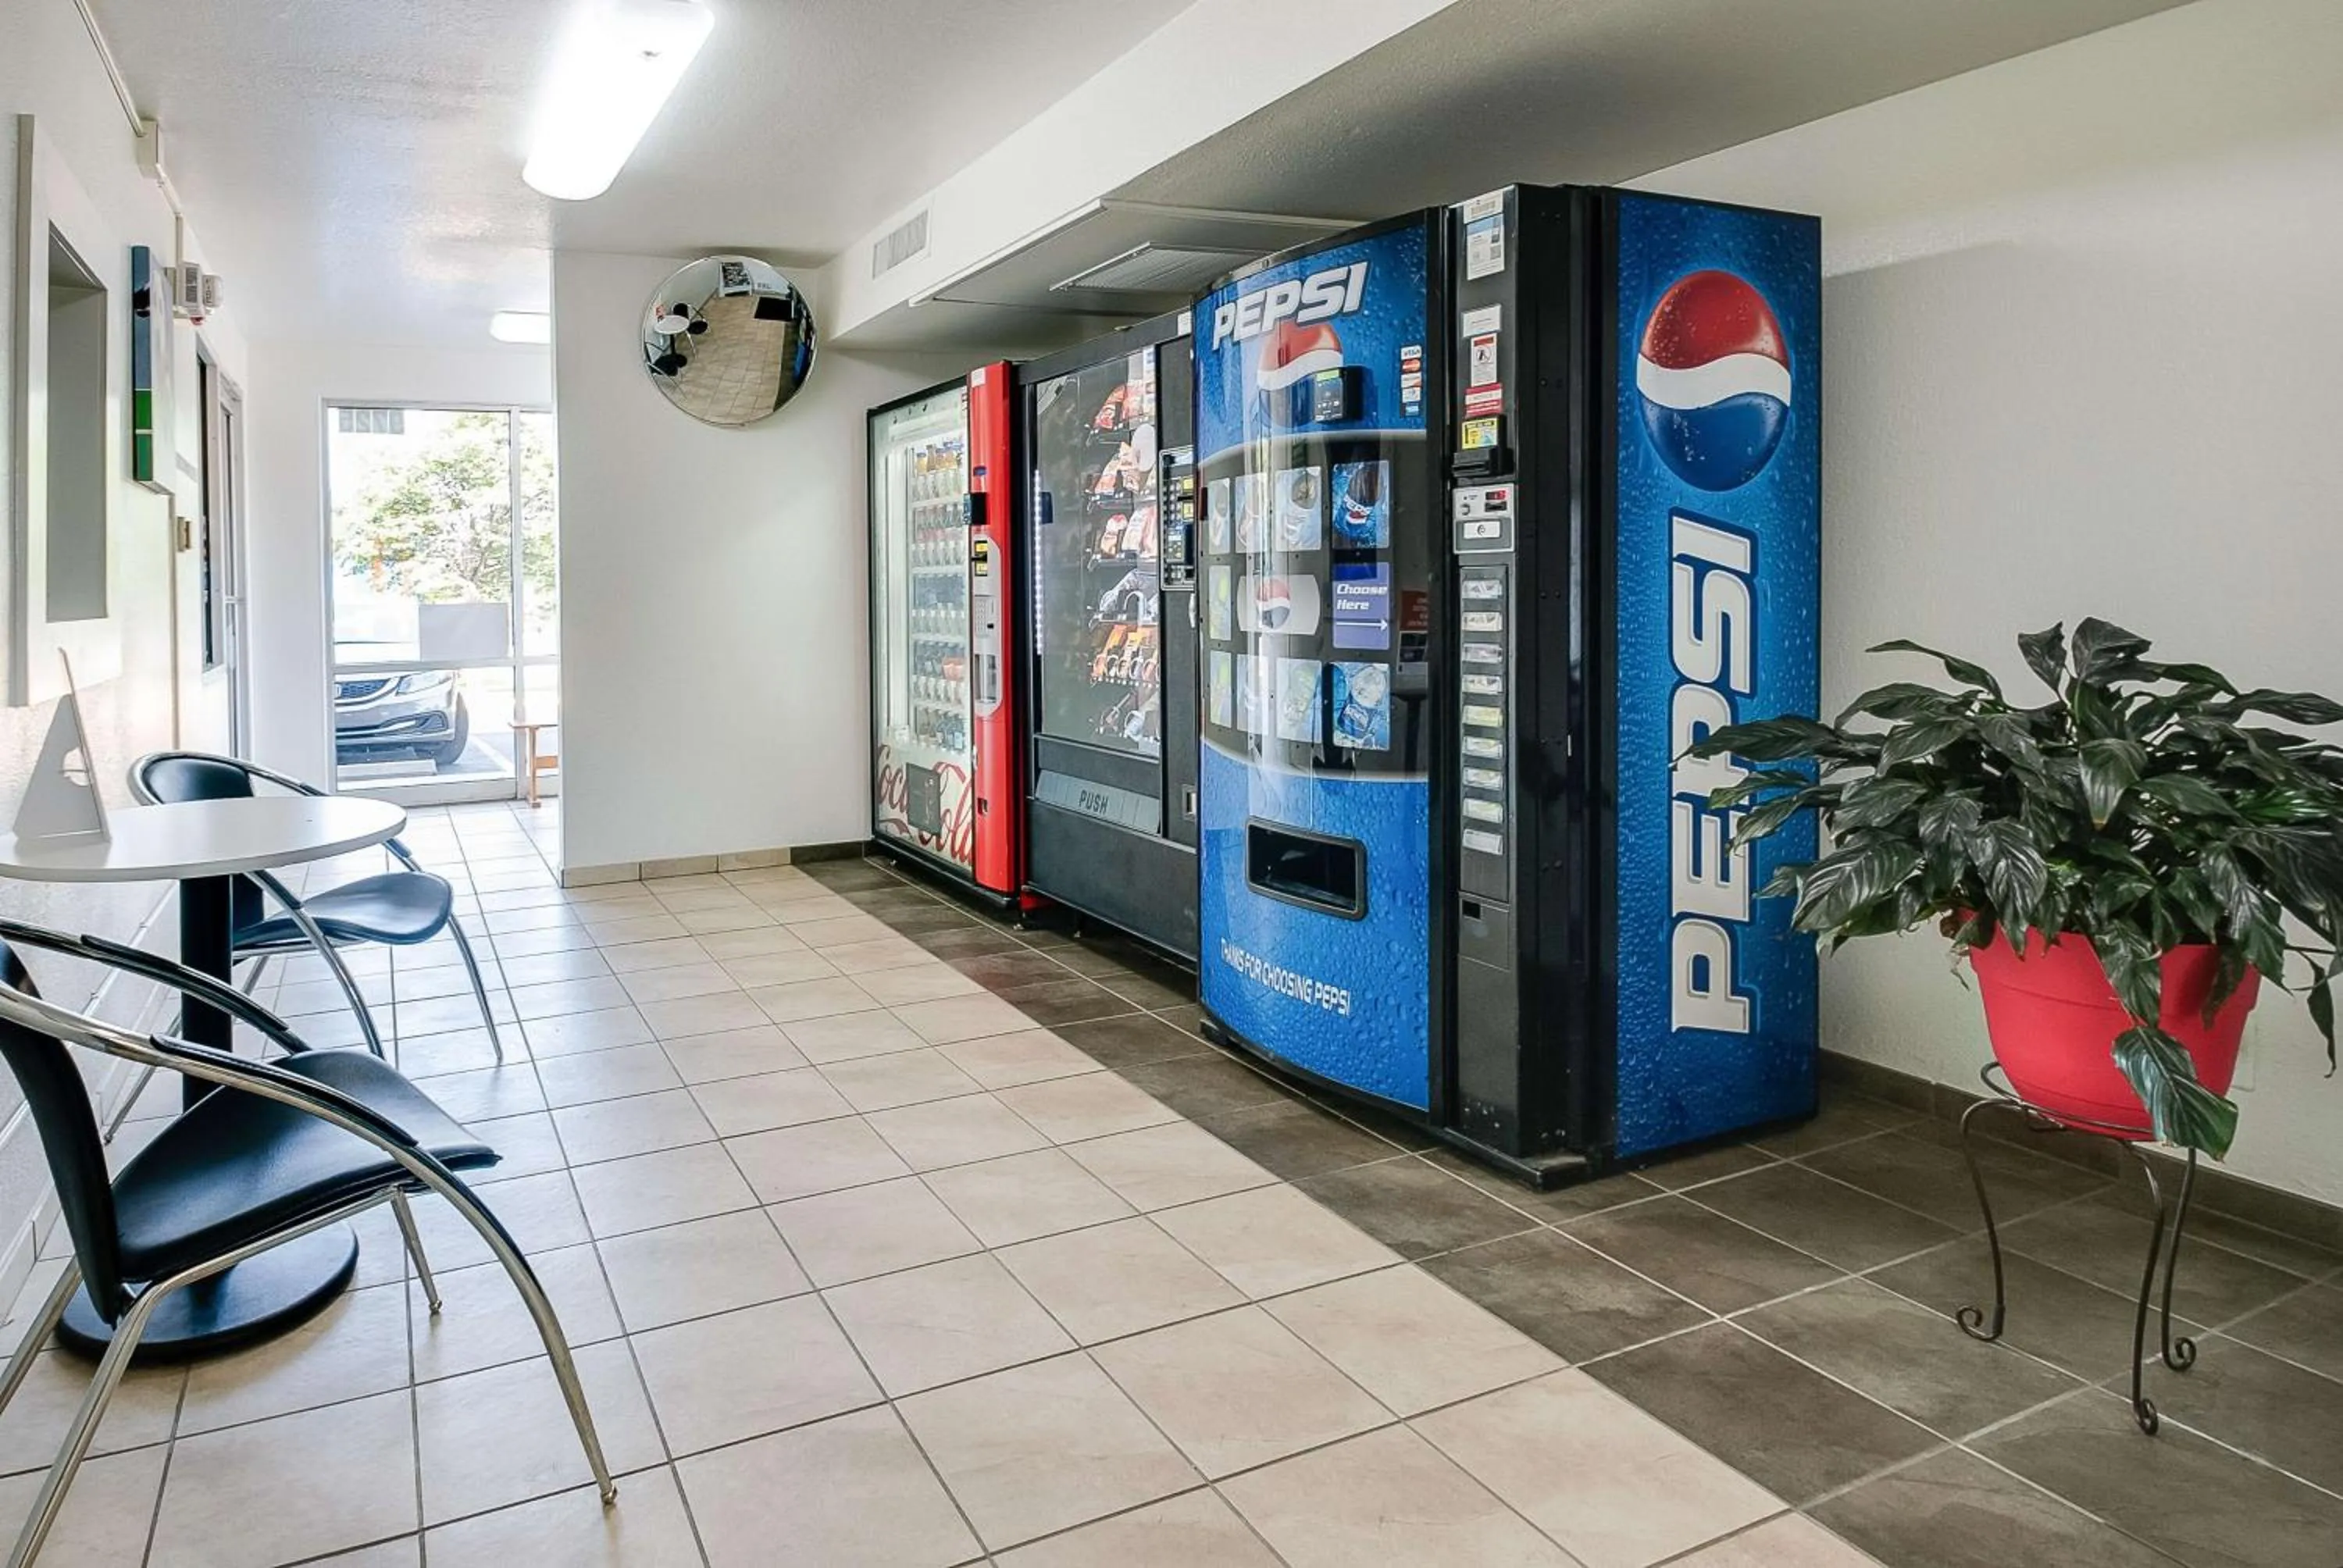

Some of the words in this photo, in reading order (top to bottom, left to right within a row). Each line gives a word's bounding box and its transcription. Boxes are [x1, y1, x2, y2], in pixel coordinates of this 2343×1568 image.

[1212, 261, 1369, 351] PEPSI
[1336, 583, 1388, 595] Choose
[1336, 599, 1370, 611] Here
[1671, 515, 1752, 1034] PEPSI
[1079, 789, 1110, 815] PUSH
[1245, 952, 1262, 982] FOR
[1262, 961, 1313, 1005] CHOOSING
[1314, 980, 1351, 1017] PEPSI
